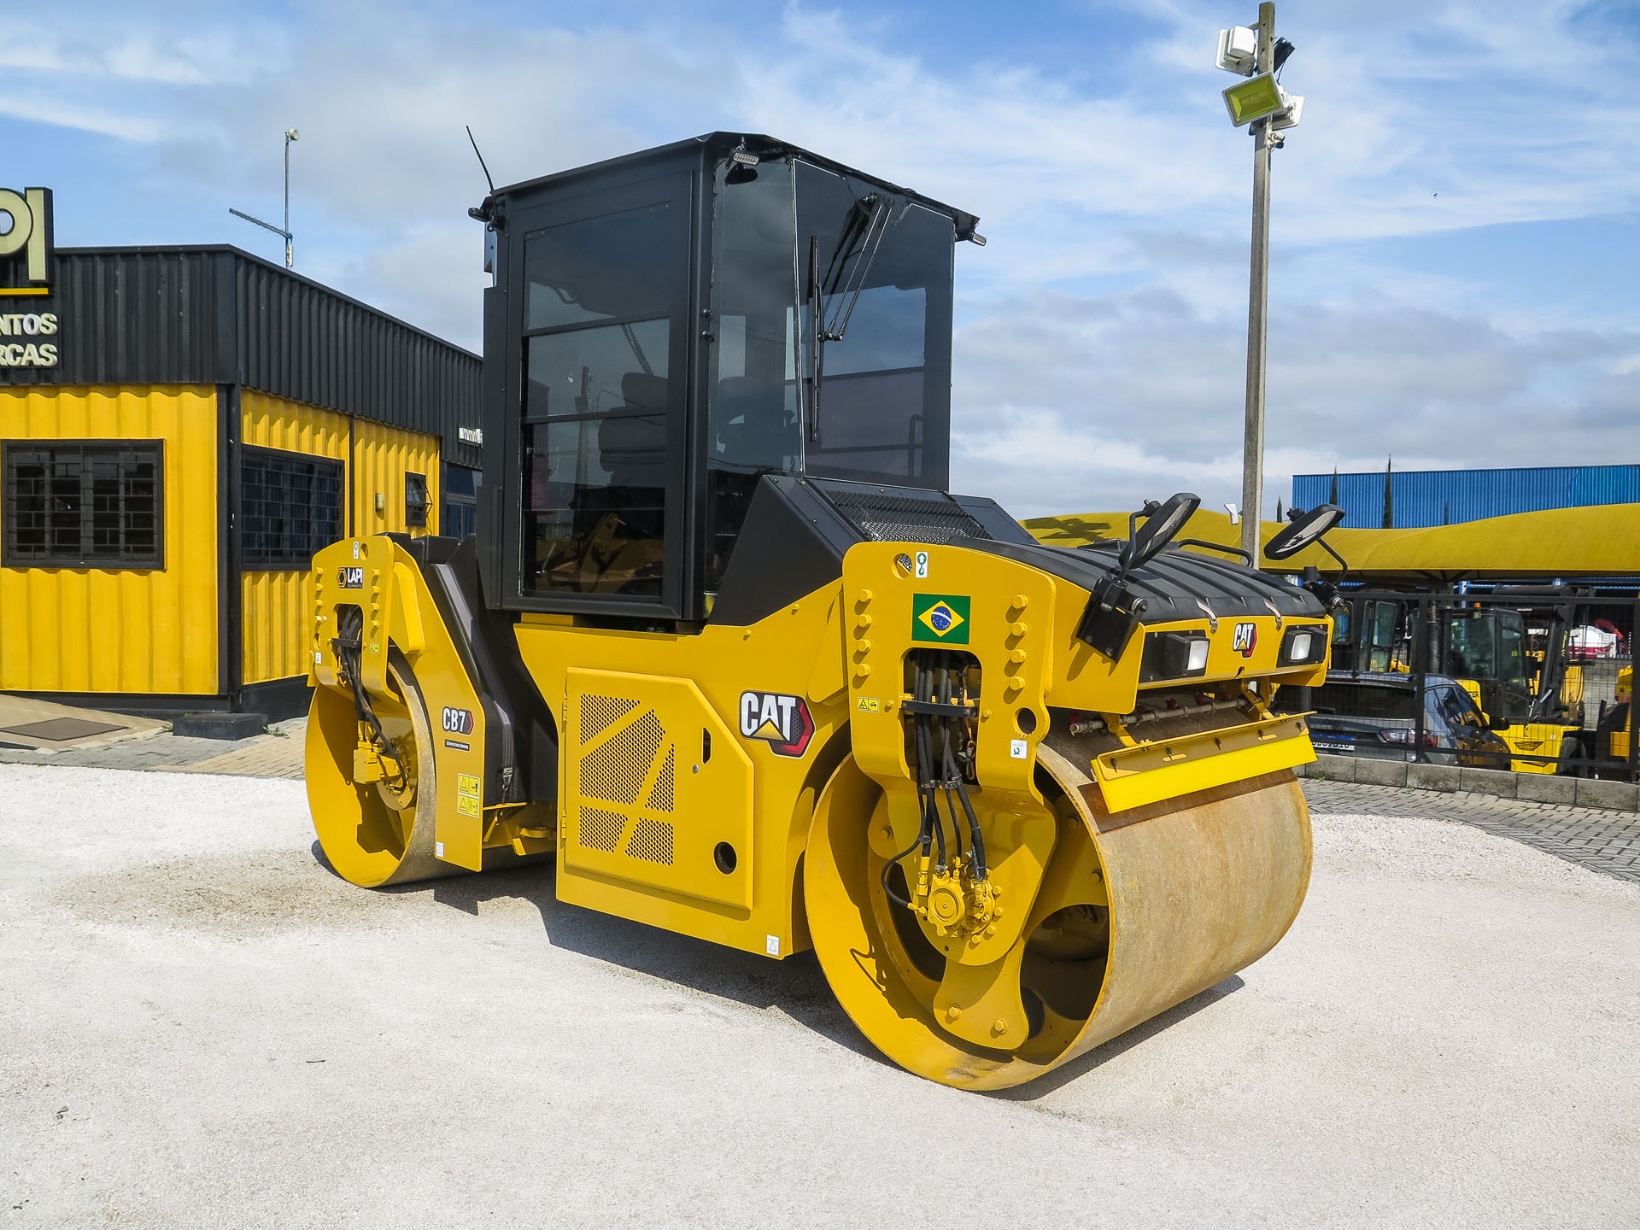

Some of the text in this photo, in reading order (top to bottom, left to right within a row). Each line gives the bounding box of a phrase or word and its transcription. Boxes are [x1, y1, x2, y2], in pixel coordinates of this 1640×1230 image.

[347, 568, 363, 583] LAPI
[1233, 623, 1254, 650] CAT
[443, 707, 466, 732] CB7
[741, 692, 796, 741] CAT
